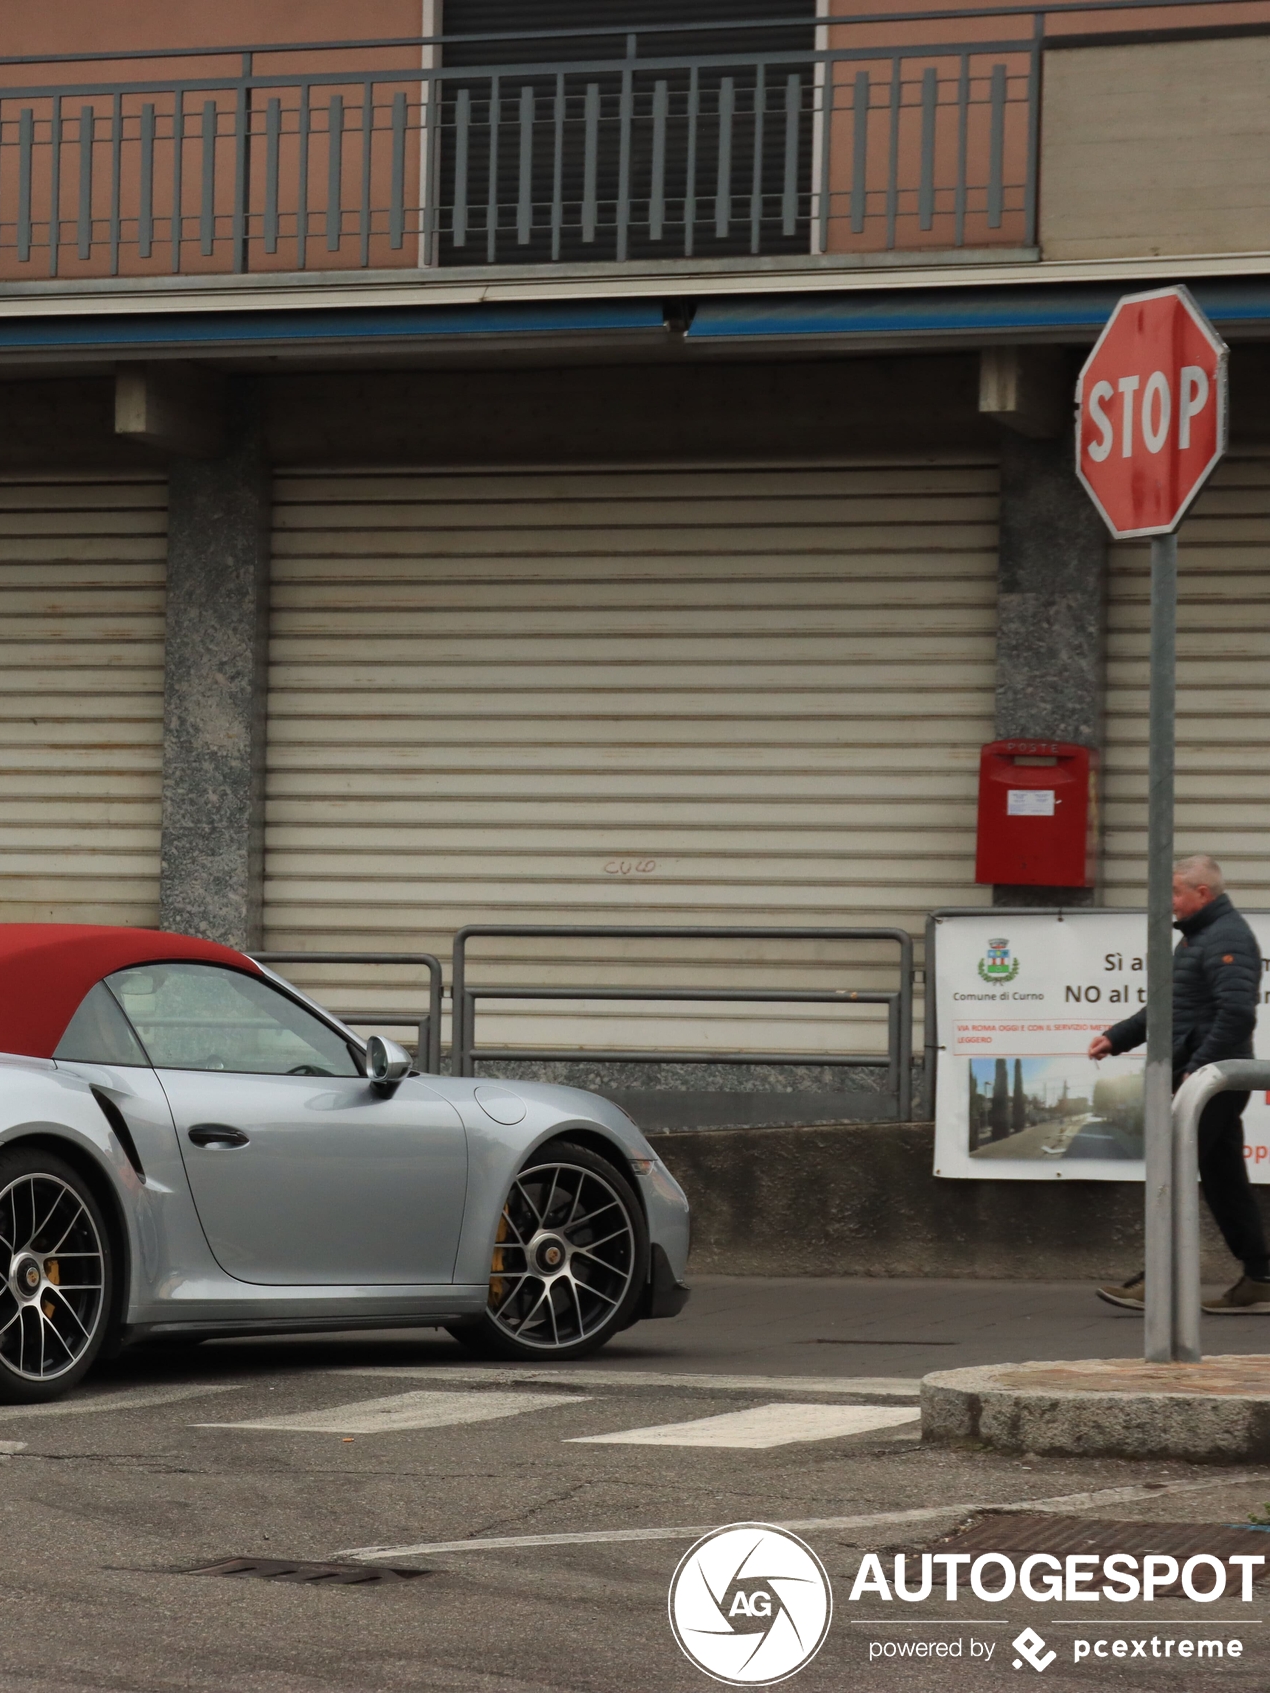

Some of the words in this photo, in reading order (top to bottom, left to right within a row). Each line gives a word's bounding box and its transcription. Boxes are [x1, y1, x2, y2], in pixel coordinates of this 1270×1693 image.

[1087, 365, 1209, 463] STOP
[1007, 742, 1059, 754] POSTE
[1104, 952, 1123, 972] Sì
[953, 992, 997, 1001] Comune
[1000, 991, 1010, 1001] di
[1012, 991, 1045, 1001] Curno
[1065, 985, 1101, 1003] NO
[1109, 985, 1129, 1003] al
[957, 1024, 970, 1032] VIA
[971, 1024, 997, 1032] ROMA
[998, 1024, 1019, 1032] OGGI
[1027, 1024, 1045, 1032] CON
[1054, 1023, 1088, 1031] SERVIZIO
[957, 1036, 992, 1044] LEGGERO
